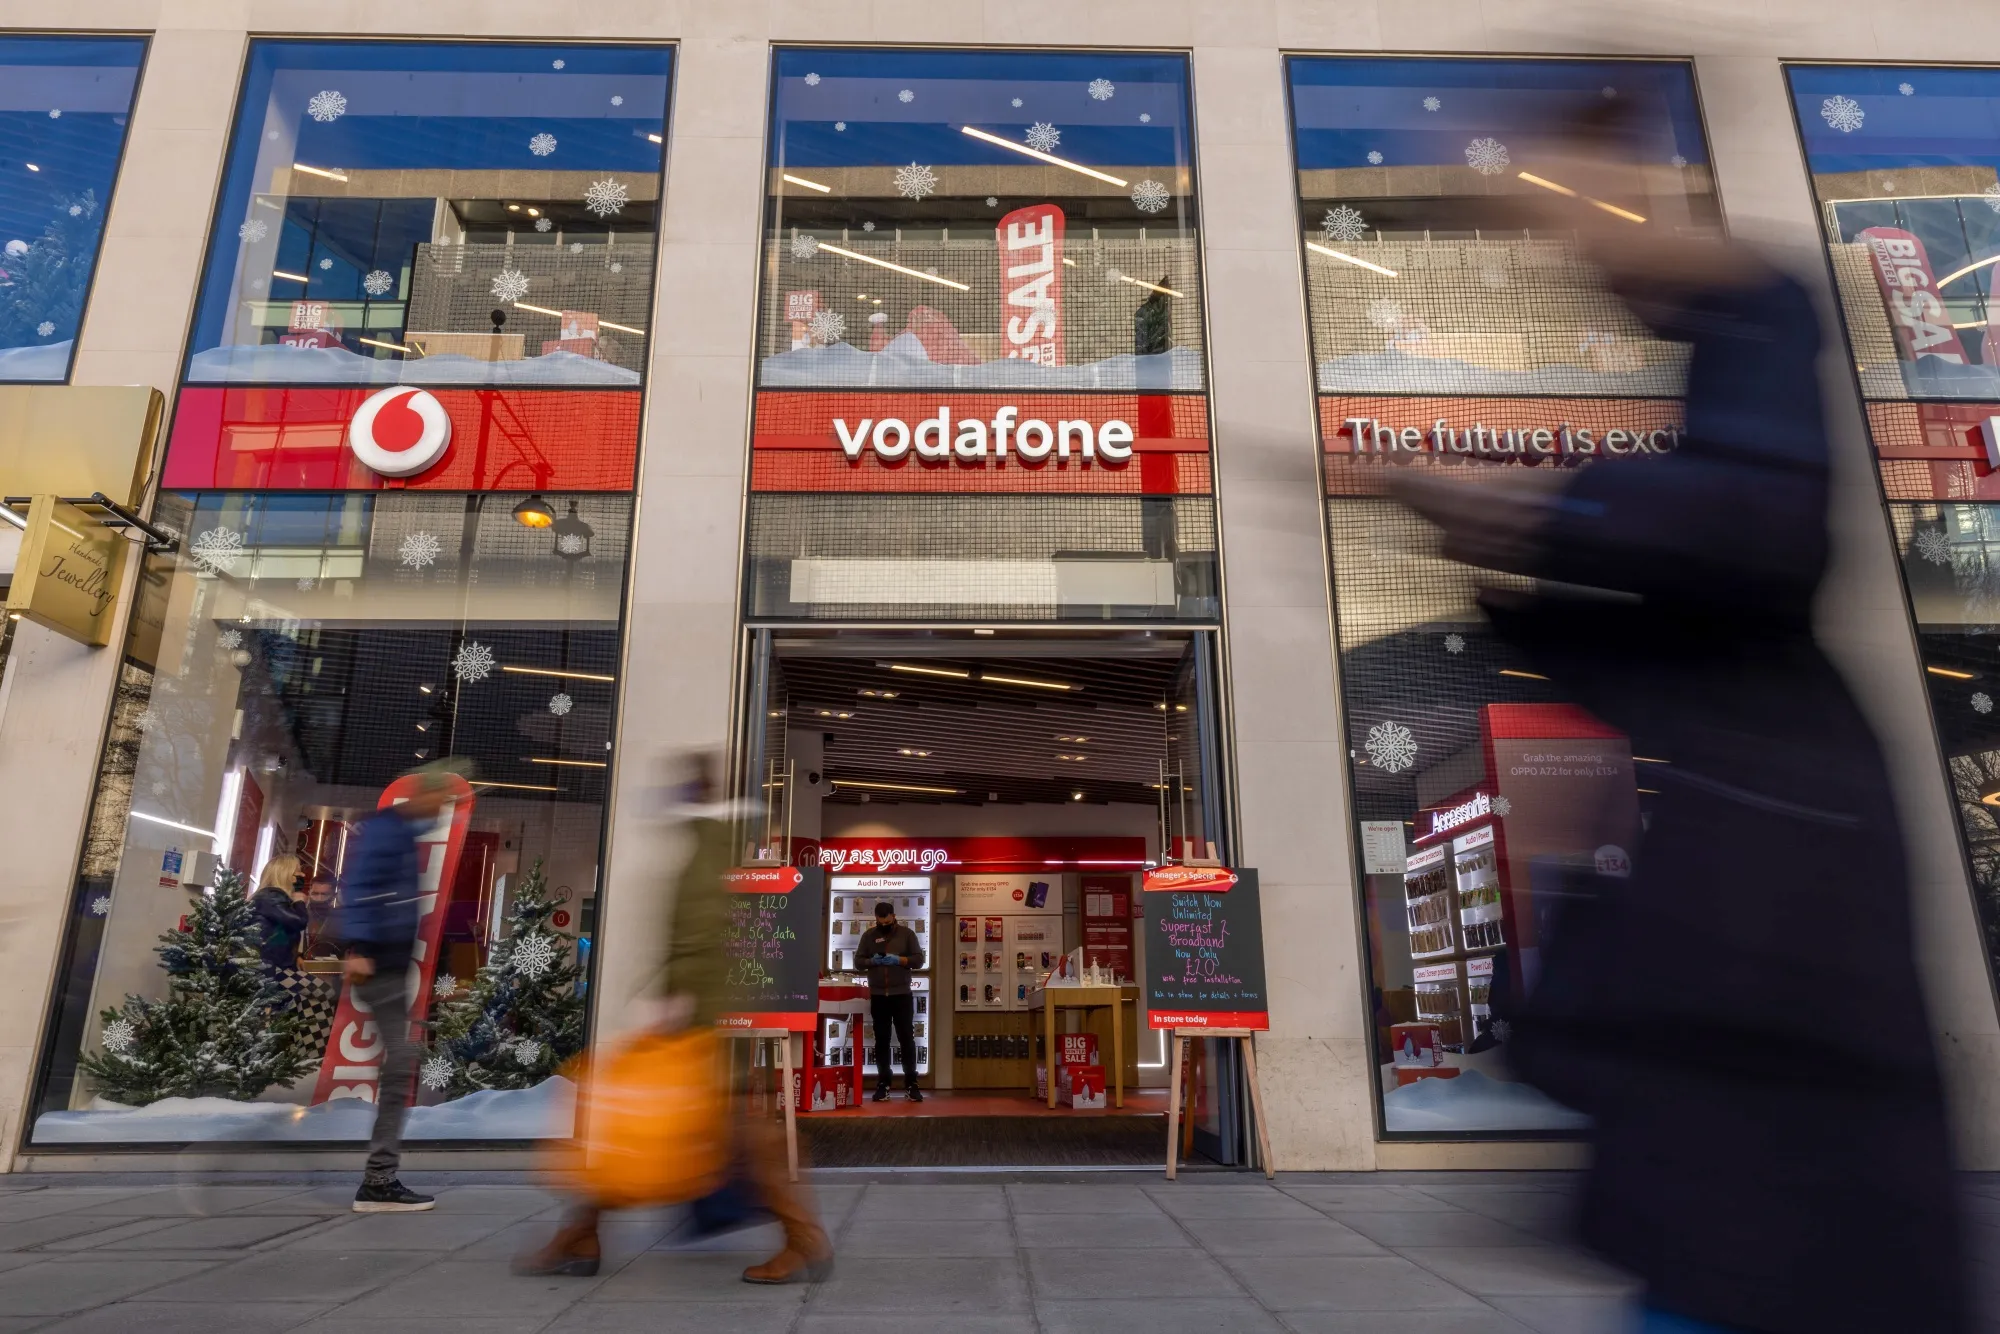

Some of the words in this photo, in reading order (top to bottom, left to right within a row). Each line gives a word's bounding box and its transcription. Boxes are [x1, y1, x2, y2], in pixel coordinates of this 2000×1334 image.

[1874, 240, 1898, 284] WINTER
[1883, 239, 1929, 288] BIG
[1008, 214, 1056, 345] SALE
[789, 294, 813, 306] BIG
[296, 304, 322, 316] BIG
[789, 312, 812, 320] SALE
[293, 322, 320, 330] SALE
[833, 405, 1135, 462] vodafone
[1346, 417, 1423, 455] The
[1432, 418, 1554, 457] future
[1560, 422, 1596, 456] is
[1606, 424, 1685, 455] exci
[69, 542, 106, 567] Handmade
[40, 556, 115, 616] Jewellery
[1523, 754, 1545, 762] Grab
[1546, 754, 1561, 762] the
[1563, 754, 1602, 763] amazing
[1511, 767, 1538, 776] OPPO
[1540, 767, 1558, 776] A72
[1559, 767, 1572, 776] for
[1574, 767, 1595, 778] only
[1596, 767, 1618, 776] £134
[851, 850, 874, 864] as
[877, 850, 916, 871] you
[921, 850, 948, 871] go
[1597, 858, 1628, 871] £134
[751, 872, 780, 882] Special
[1149, 871, 1187, 881] Manager's
[1188, 872, 1216, 881] Special
[759, 895, 788, 910] £120
[1172, 893, 1198, 907] Switch
[1204, 894, 1222, 908] Now
[1172, 908, 1213, 920] Unlimited
[754, 918, 772, 932] Only
[1161, 919, 1213, 937] Superfast
[748, 926, 764, 941] 5G
[772, 925, 796, 940] data
[762, 938, 781, 948] calls
[1169, 934, 1224, 948] Broadband
[761, 949, 783, 960] texts
[1175, 949, 1191, 958] Now
[1199, 947, 1220, 966] Only
[740, 958, 765, 976] Only
[1186, 958, 1215, 976] £20
[1183, 977, 1197, 985] free
[729, 1017, 752, 1027] today
[1154, 1015, 1162, 1023] In
[1164, 1015, 1184, 1023] store
[1185, 1015, 1208, 1024] today
[1065, 1037, 1086, 1049] BIG
[1065, 1055, 1086, 1063] SALE
